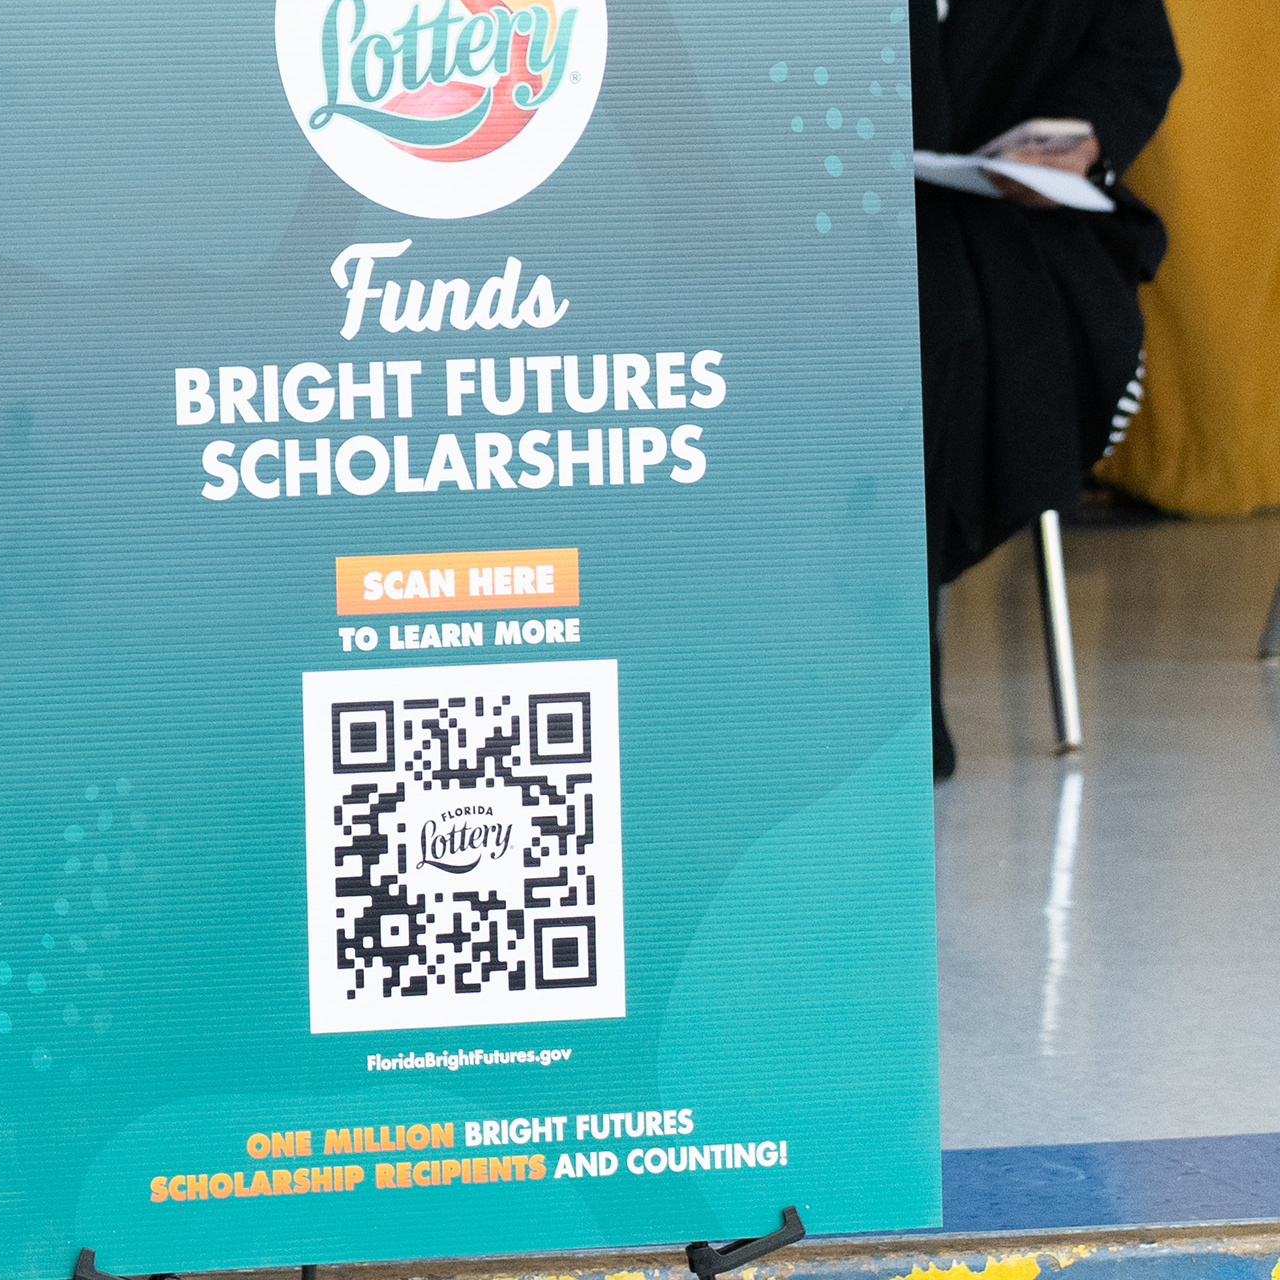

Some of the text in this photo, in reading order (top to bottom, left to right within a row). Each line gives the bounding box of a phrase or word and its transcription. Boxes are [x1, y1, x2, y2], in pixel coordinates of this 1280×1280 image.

[330, 238, 570, 341] Funds
[174, 349, 728, 426] BRIGHT FUTURES
[201, 423, 708, 502] SCHOLARSHIPS
[362, 564, 555, 602] SCAN HERE
[339, 618, 581, 652] TO LEARN MORE
[441, 805, 494, 822] FLORIDA
[416, 819, 513, 875] Lottery
[366, 1046, 573, 1072] FloridaBrightFutures.gov
[246, 1108, 694, 1160] ONE MILLION BRIGHT FUTURES
[149, 1140, 788, 1203] SCHOLARSHIP RECIPIENTS AND COUNTING!
